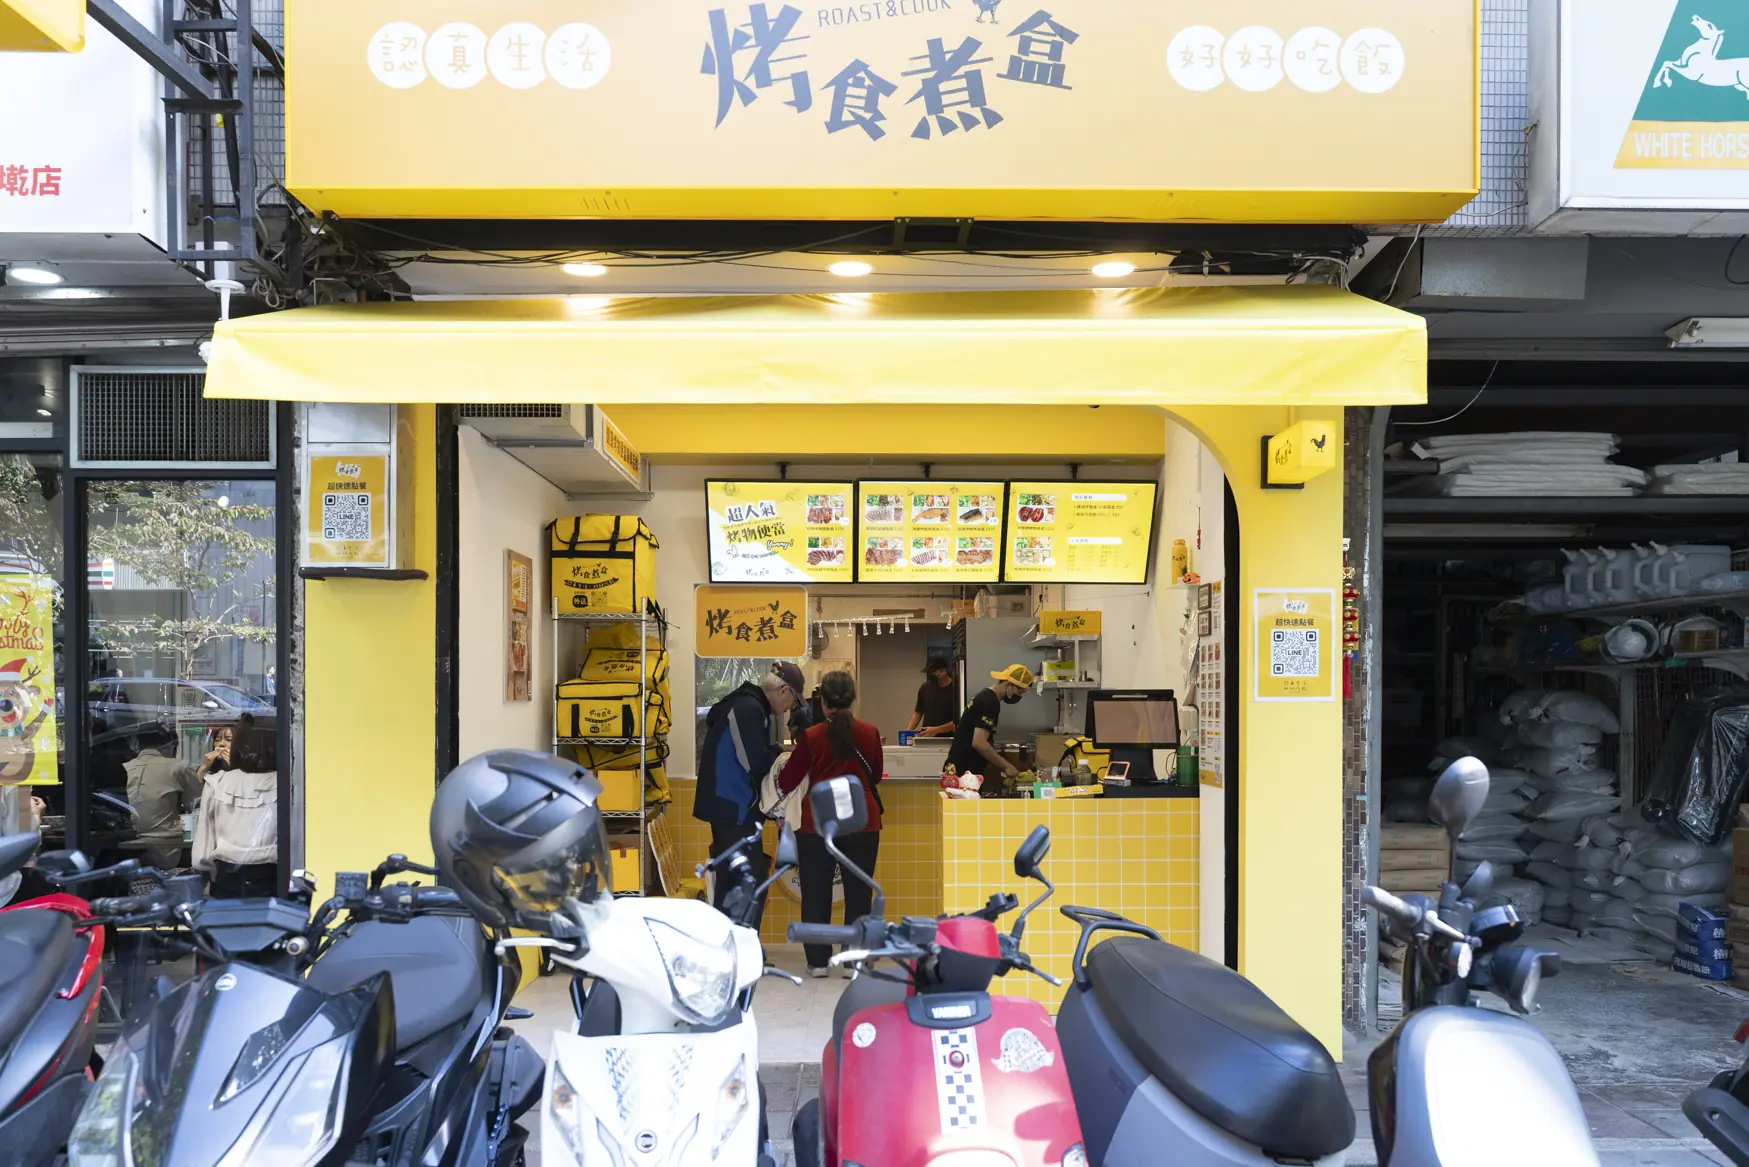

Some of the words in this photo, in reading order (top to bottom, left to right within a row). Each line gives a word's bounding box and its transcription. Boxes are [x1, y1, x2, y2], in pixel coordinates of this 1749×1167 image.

[818, 0, 951, 27] ROAST&COOK
[379, 30, 597, 74] 認真生活
[1178, 38, 1393, 76] 好好吃飯
[700, 2, 1080, 142] 烤食煮盒
[1634, 131, 1694, 159] WHITE
[727, 501, 776, 523] 超人氣
[726, 521, 787, 543] 烤物便當
[705, 607, 798, 643] 烤食煮盒
